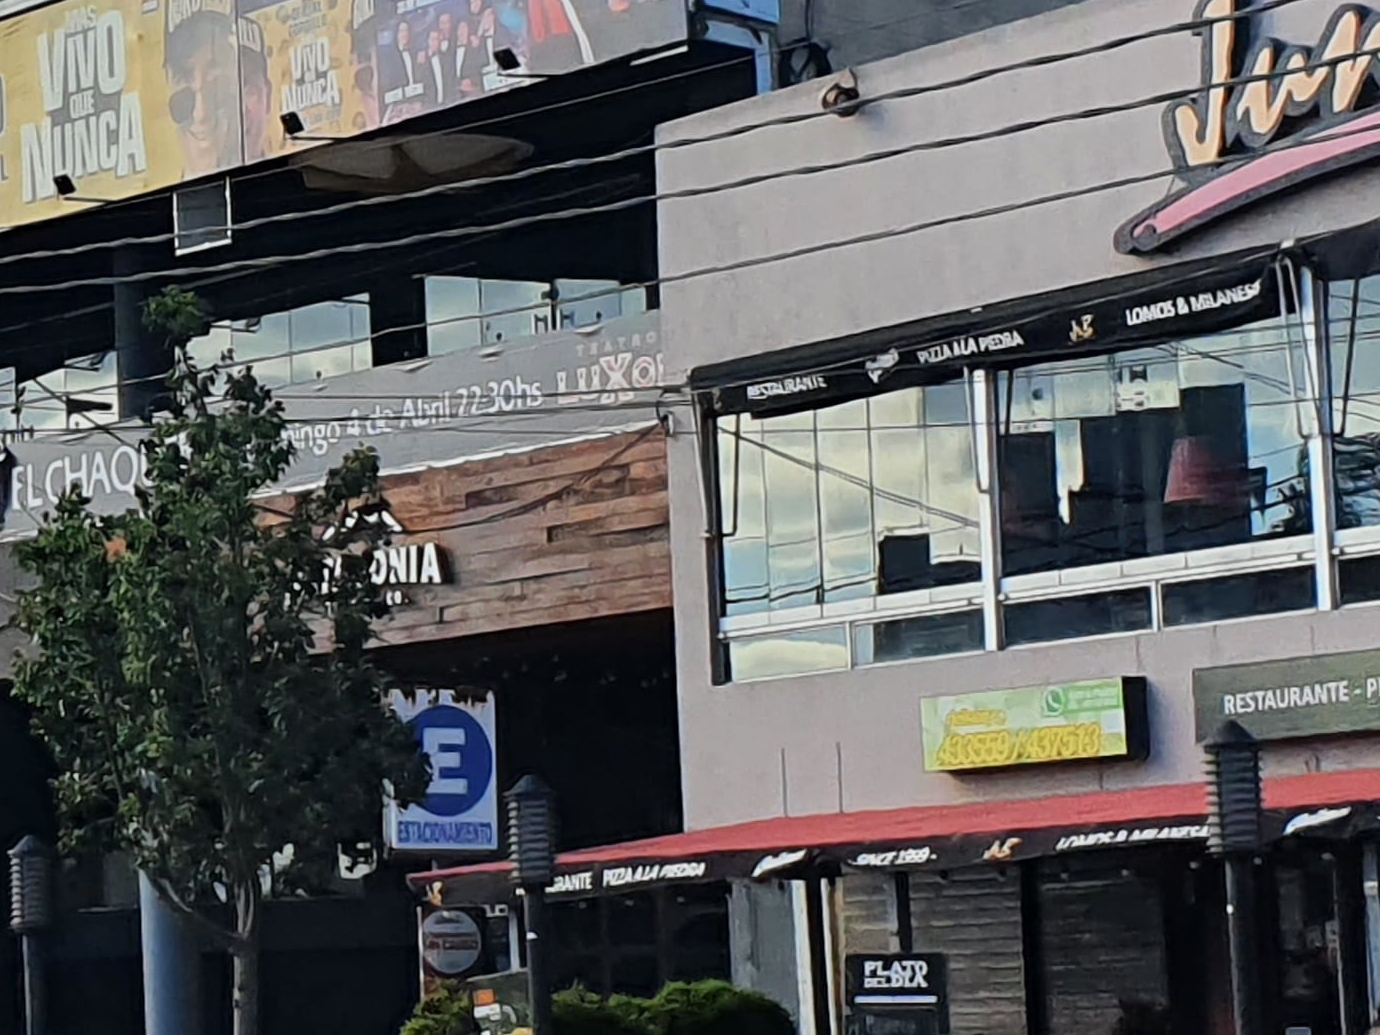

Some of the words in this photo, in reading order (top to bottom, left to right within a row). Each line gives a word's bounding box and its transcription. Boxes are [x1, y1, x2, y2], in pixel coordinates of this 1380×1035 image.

[37, 9, 126, 112] VIVO
[69, 89, 96, 120] QUE
[281, 70, 340, 114] NUNCA
[22, 91, 148, 204] NUNCA
[1126, 300, 1175, 326] LOMOS
[555, 352, 664, 406] LUXO
[347, 407, 361, 438] 4
[400, 389, 452, 432] Abril
[11, 464, 44, 510] EL
[1224, 679, 1350, 715] RESTAURANTE
[423, 727, 469, 795] E
[398, 820, 493, 846] ESTACIONAMIENTO
[602, 867, 632, 887] PIZZA
